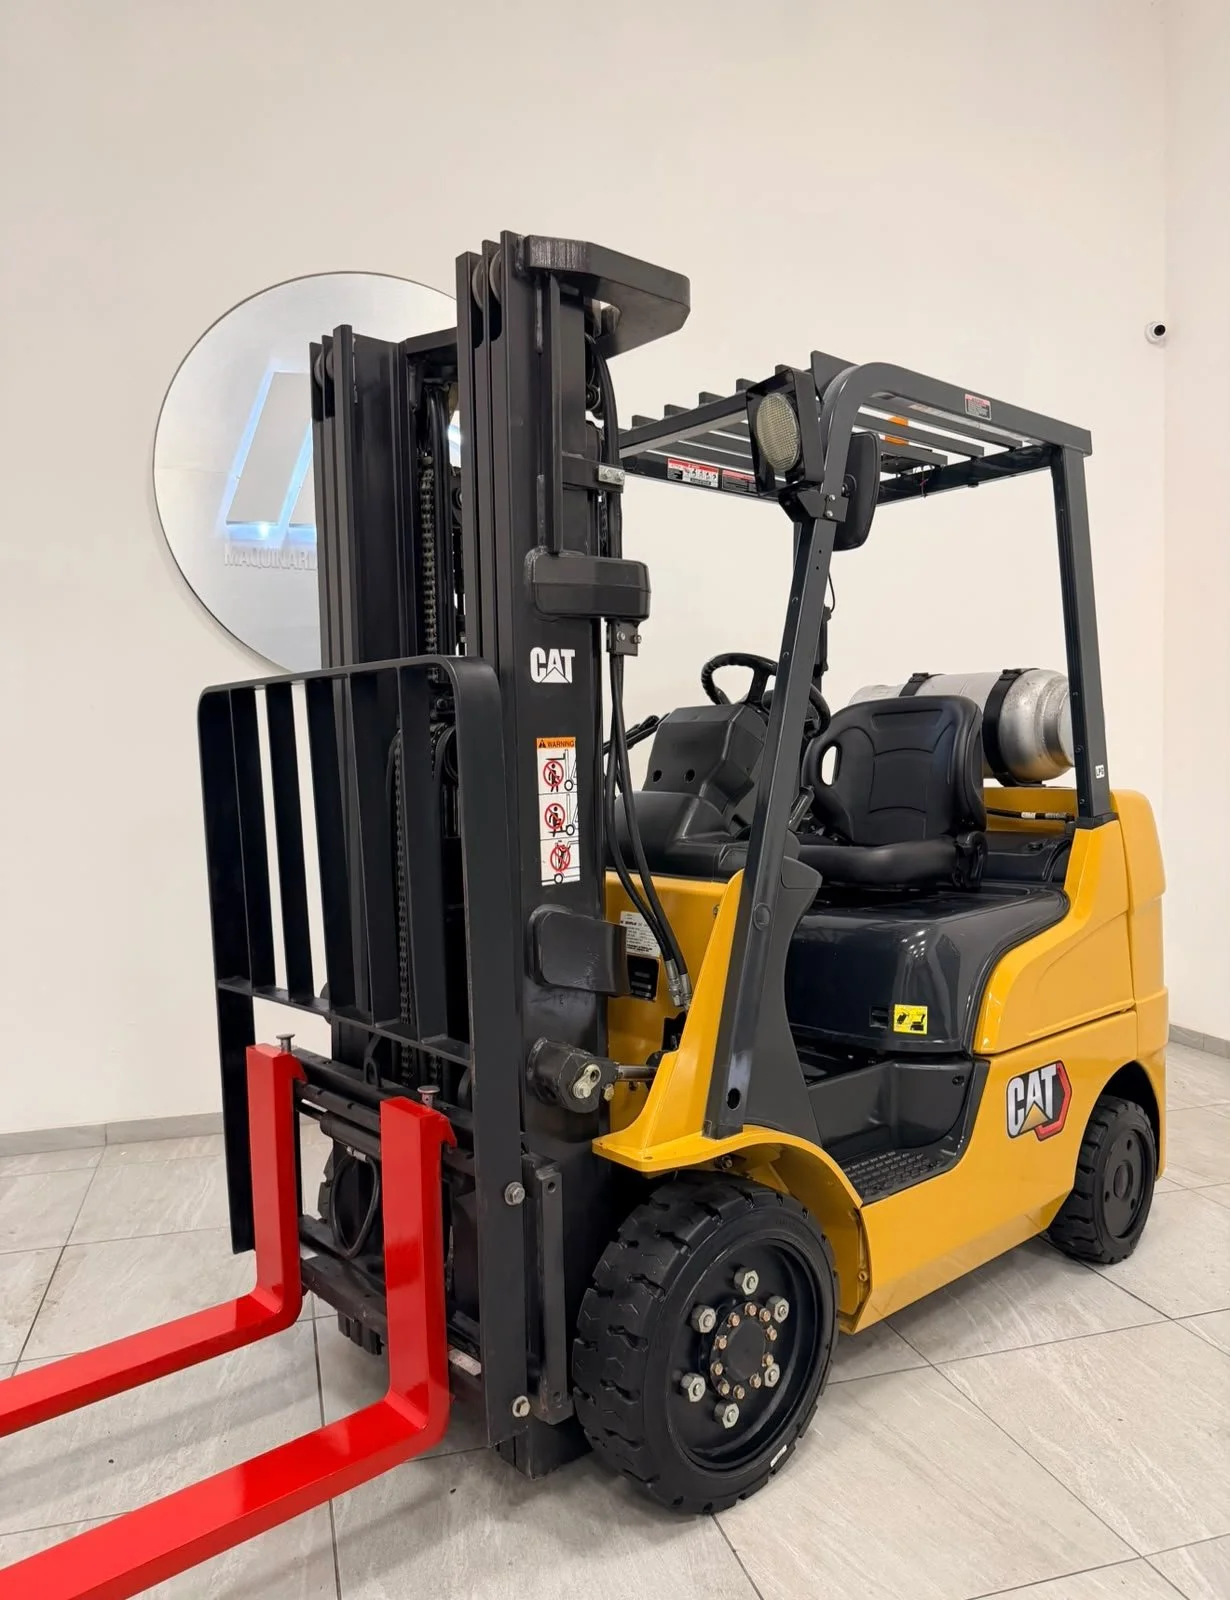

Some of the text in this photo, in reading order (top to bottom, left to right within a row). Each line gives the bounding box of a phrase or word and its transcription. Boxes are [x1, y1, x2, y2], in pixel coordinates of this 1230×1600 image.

[530, 647, 575, 683] CAT
[547, 740, 574, 748] WARNING
[1007, 1063, 1057, 1136] CAT
